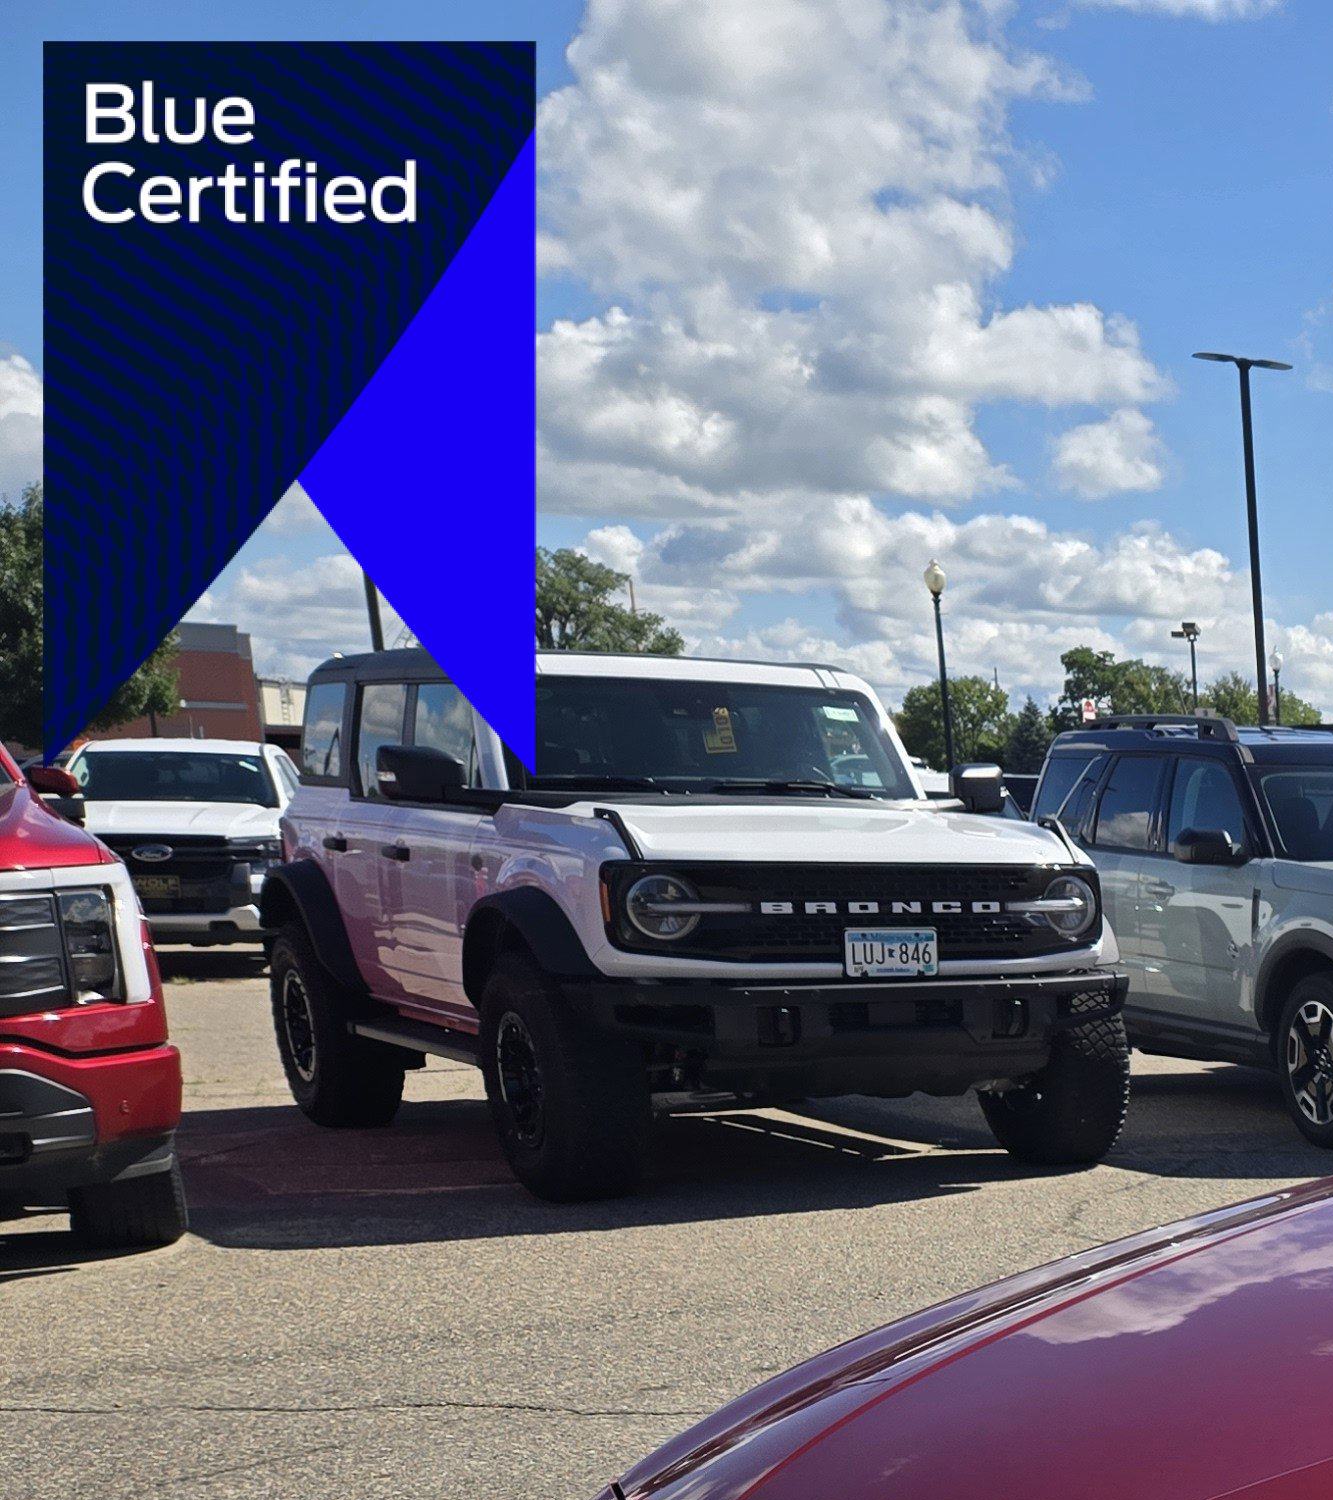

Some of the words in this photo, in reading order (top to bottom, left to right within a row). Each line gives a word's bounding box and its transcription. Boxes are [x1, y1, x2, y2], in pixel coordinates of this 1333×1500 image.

[760, 901, 1000, 914] BRONCO
[852, 942, 885, 965] LUJ
[899, 942, 932, 965] 846
